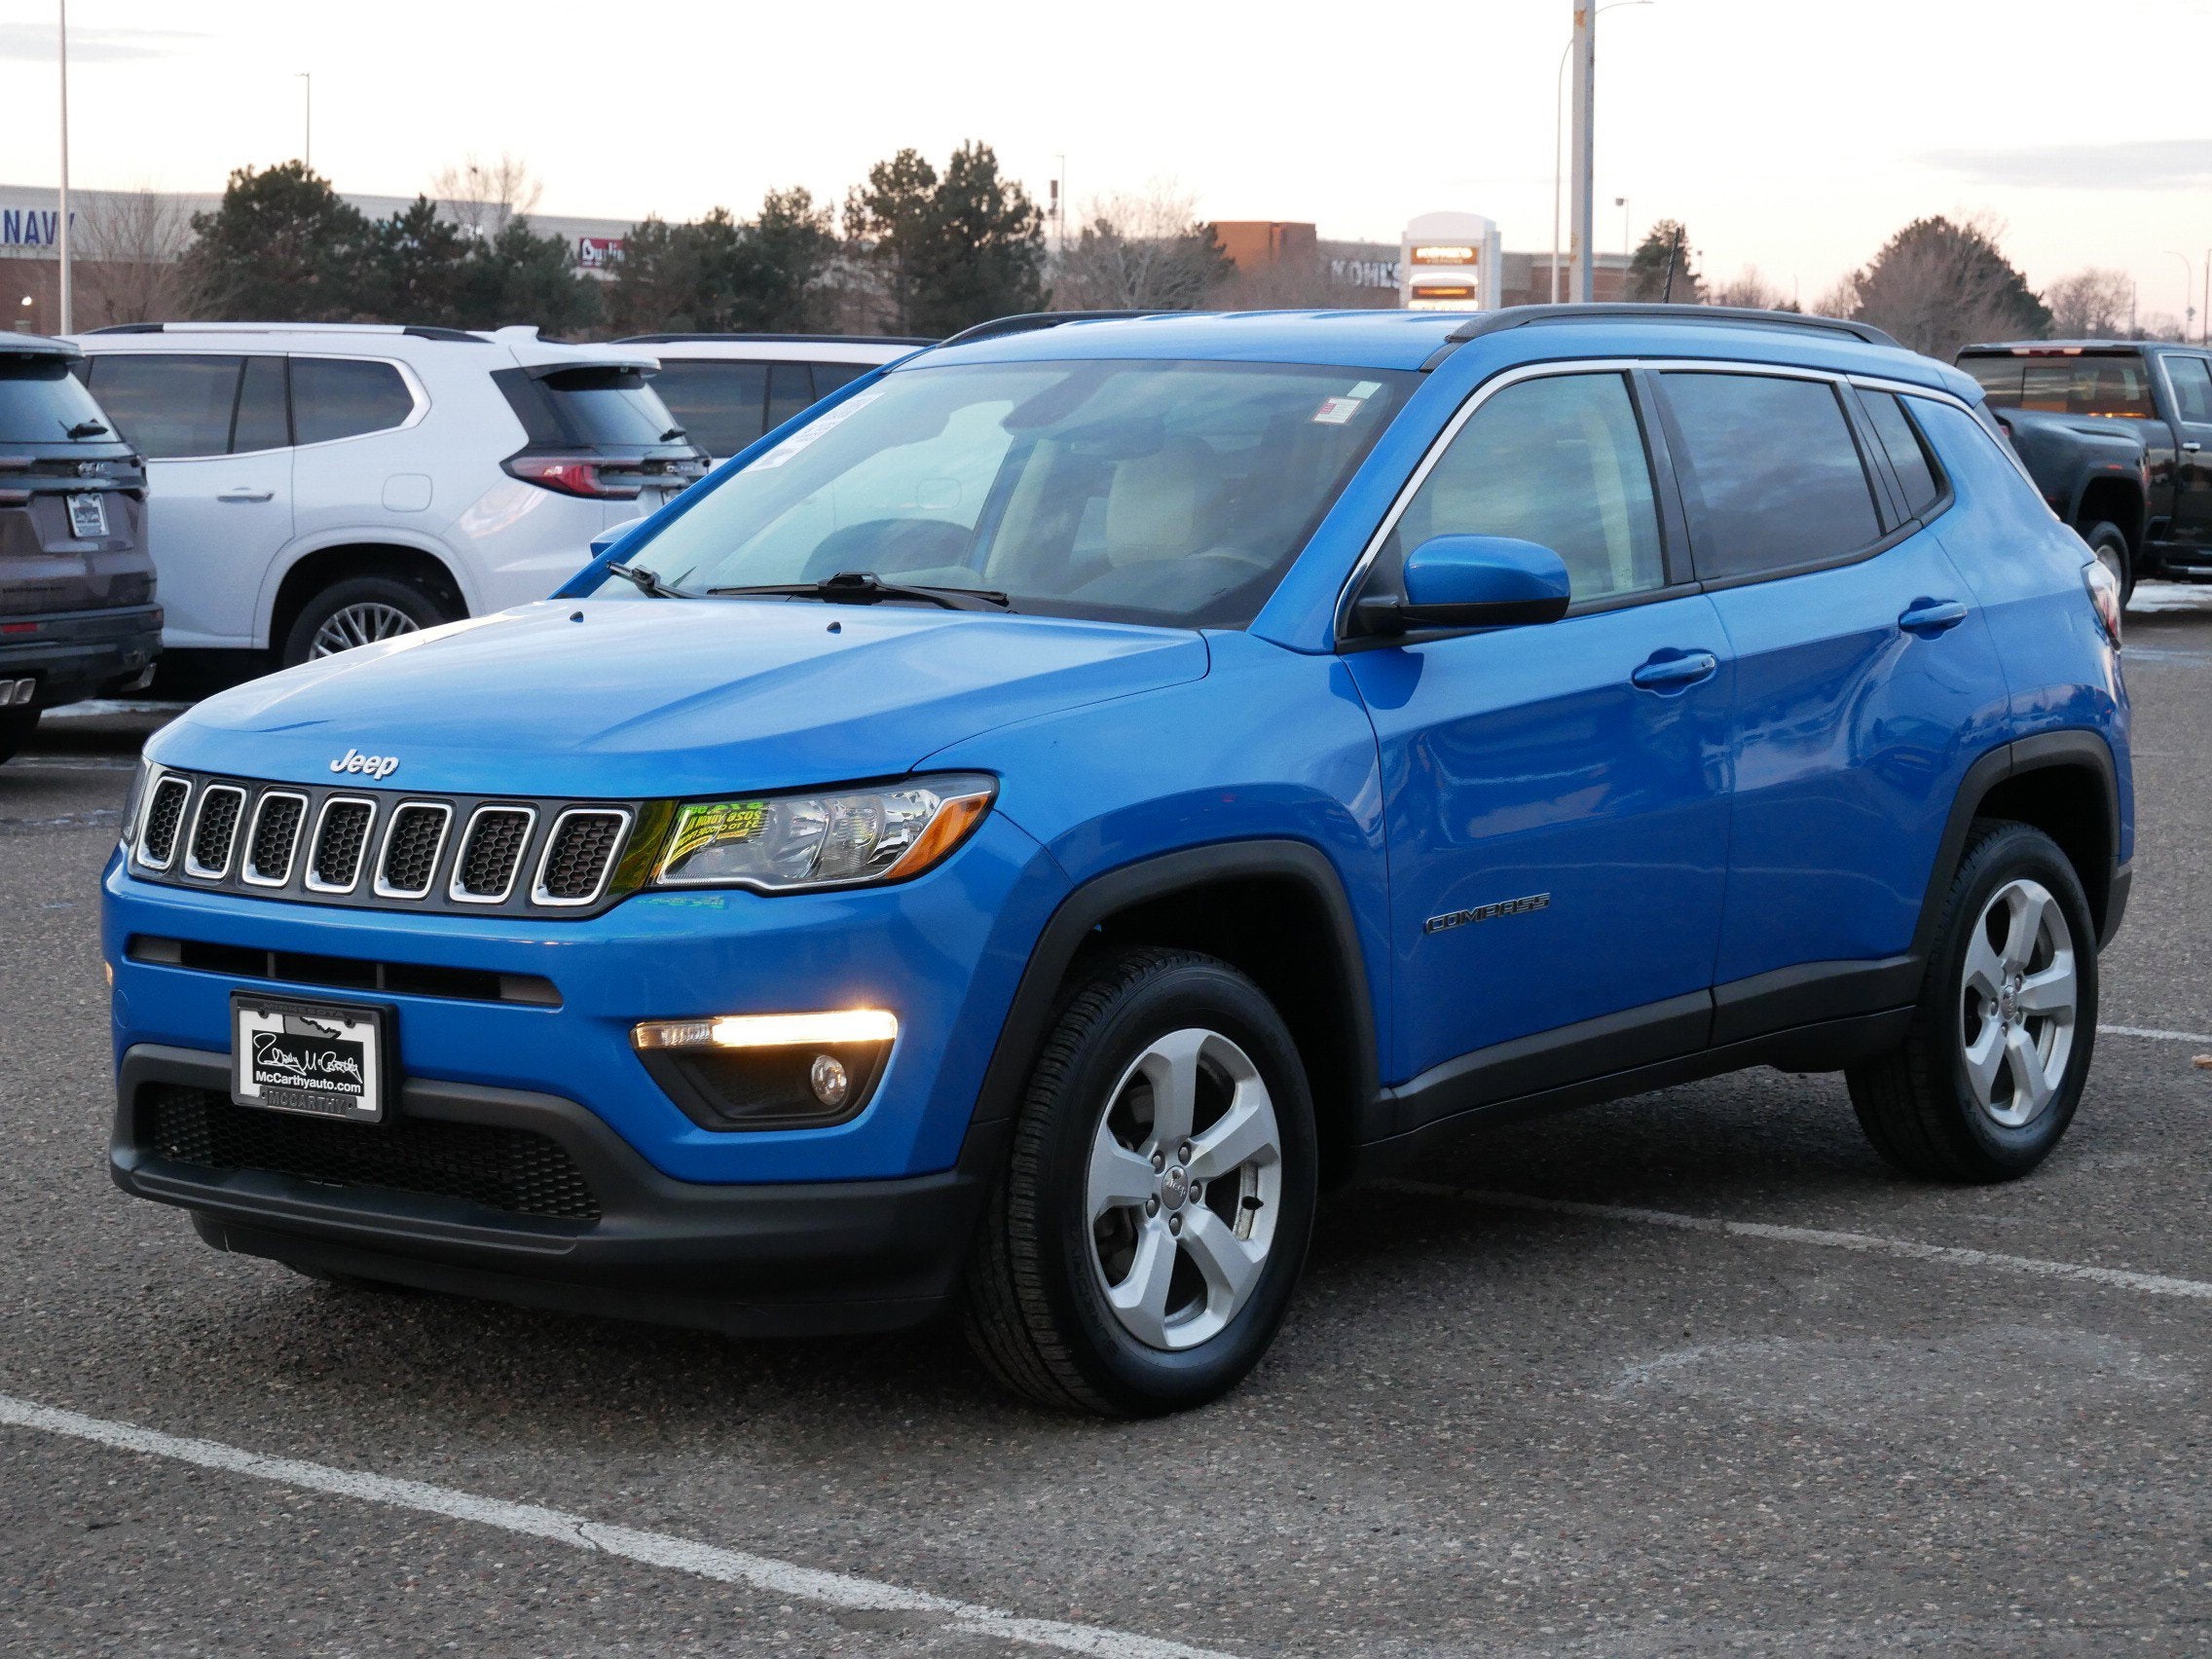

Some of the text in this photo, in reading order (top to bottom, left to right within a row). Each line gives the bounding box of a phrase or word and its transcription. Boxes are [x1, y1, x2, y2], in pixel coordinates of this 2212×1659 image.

[330, 749, 400, 781] Jeep
[1426, 892, 1550, 935] COMPASS
[255, 1071, 361, 1093] McCarthyauto.com
